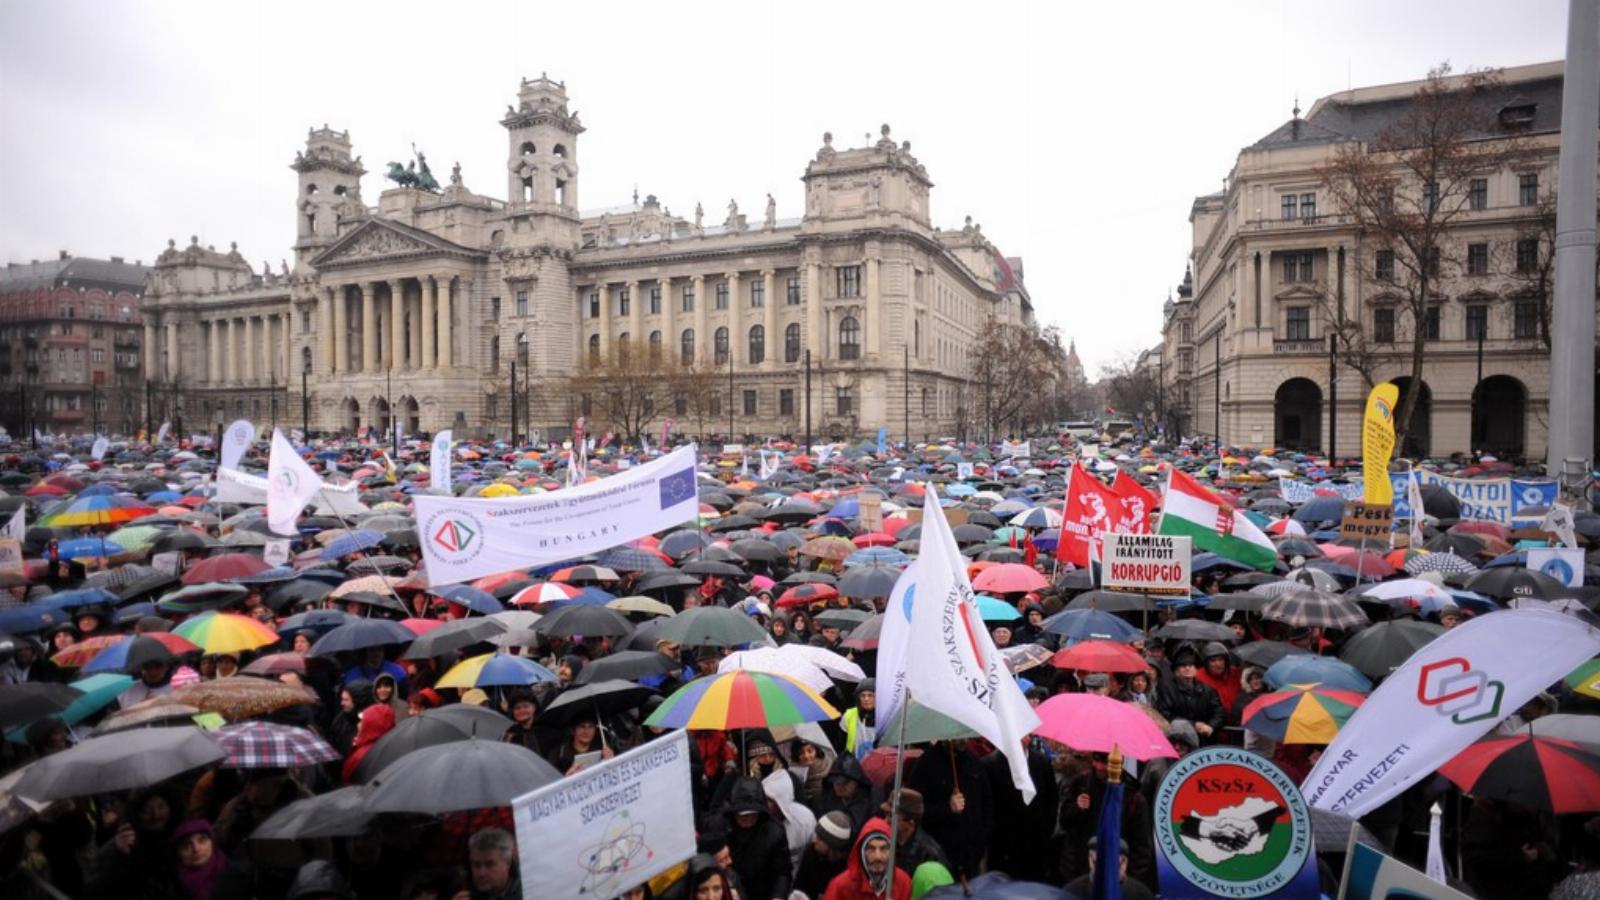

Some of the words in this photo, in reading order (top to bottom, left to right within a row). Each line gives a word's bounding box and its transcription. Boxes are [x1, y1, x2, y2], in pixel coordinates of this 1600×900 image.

[1352, 506, 1391, 519] Pest
[539, 524, 619, 548] HUNGARY
[1344, 523, 1390, 536] megye
[1115, 546, 1174, 560] IRÁNYÍTOTT
[1197, 778, 1256, 793] KSzSz
[1308, 749, 1359, 807] MAGYAR
[528, 788, 568, 822] MAGYAR
[580, 781, 641, 824] SZAKSZERVEZET
[1216, 752, 1306, 856] SZAKSZERVEZETEK
[1190, 871, 1284, 897] SZÖVETSÉGE
